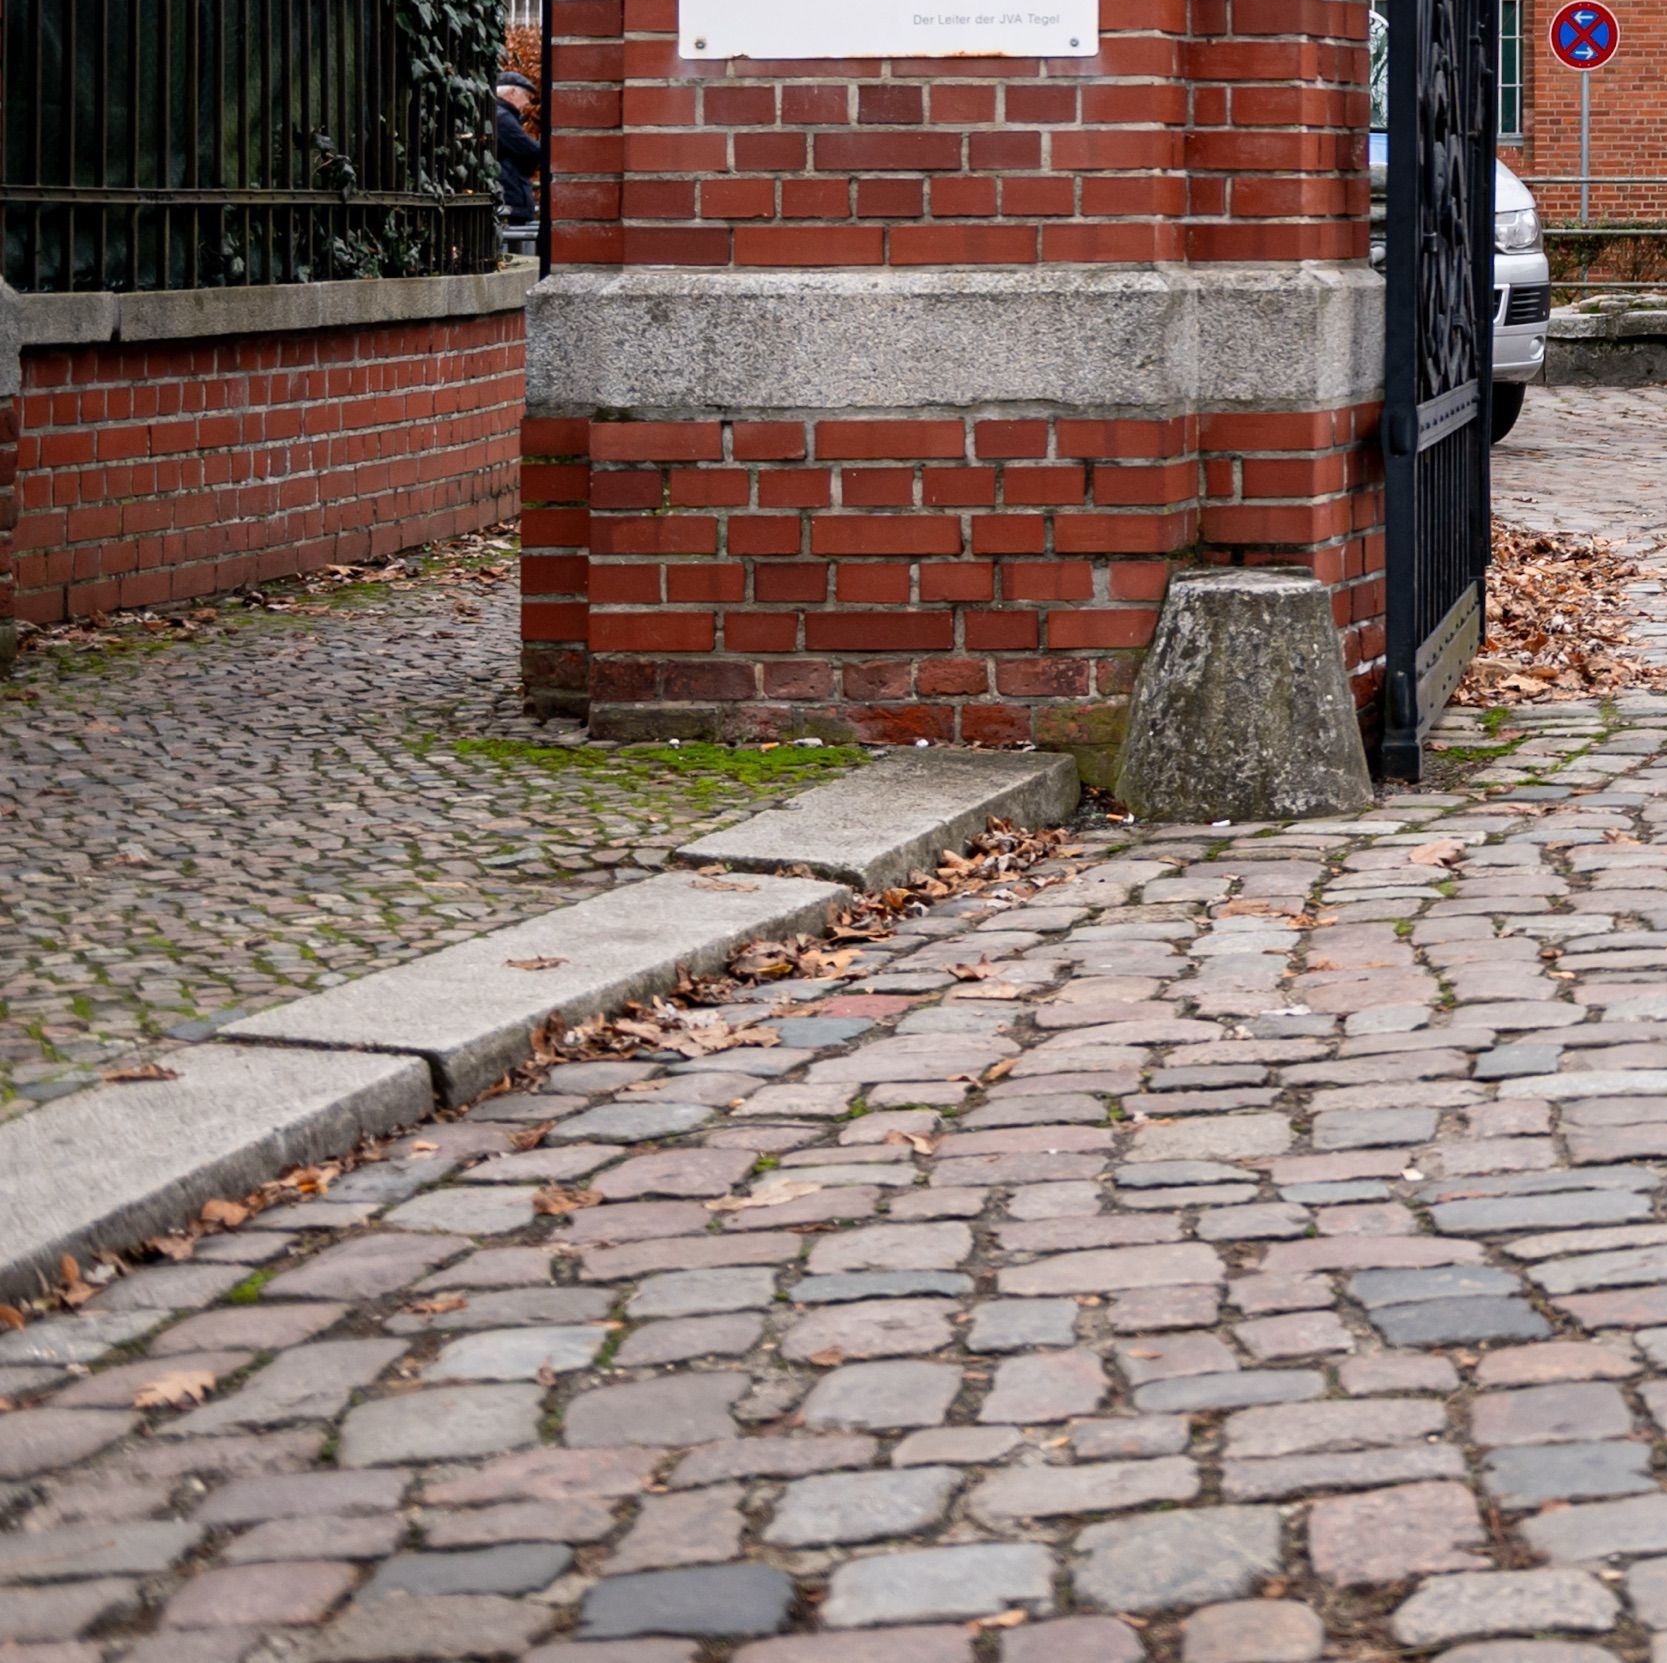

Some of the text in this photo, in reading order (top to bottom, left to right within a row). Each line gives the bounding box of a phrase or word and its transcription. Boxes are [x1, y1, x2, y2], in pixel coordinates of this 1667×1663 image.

[913, 12, 1060, 26] Der Leiter der JVA Tegel
